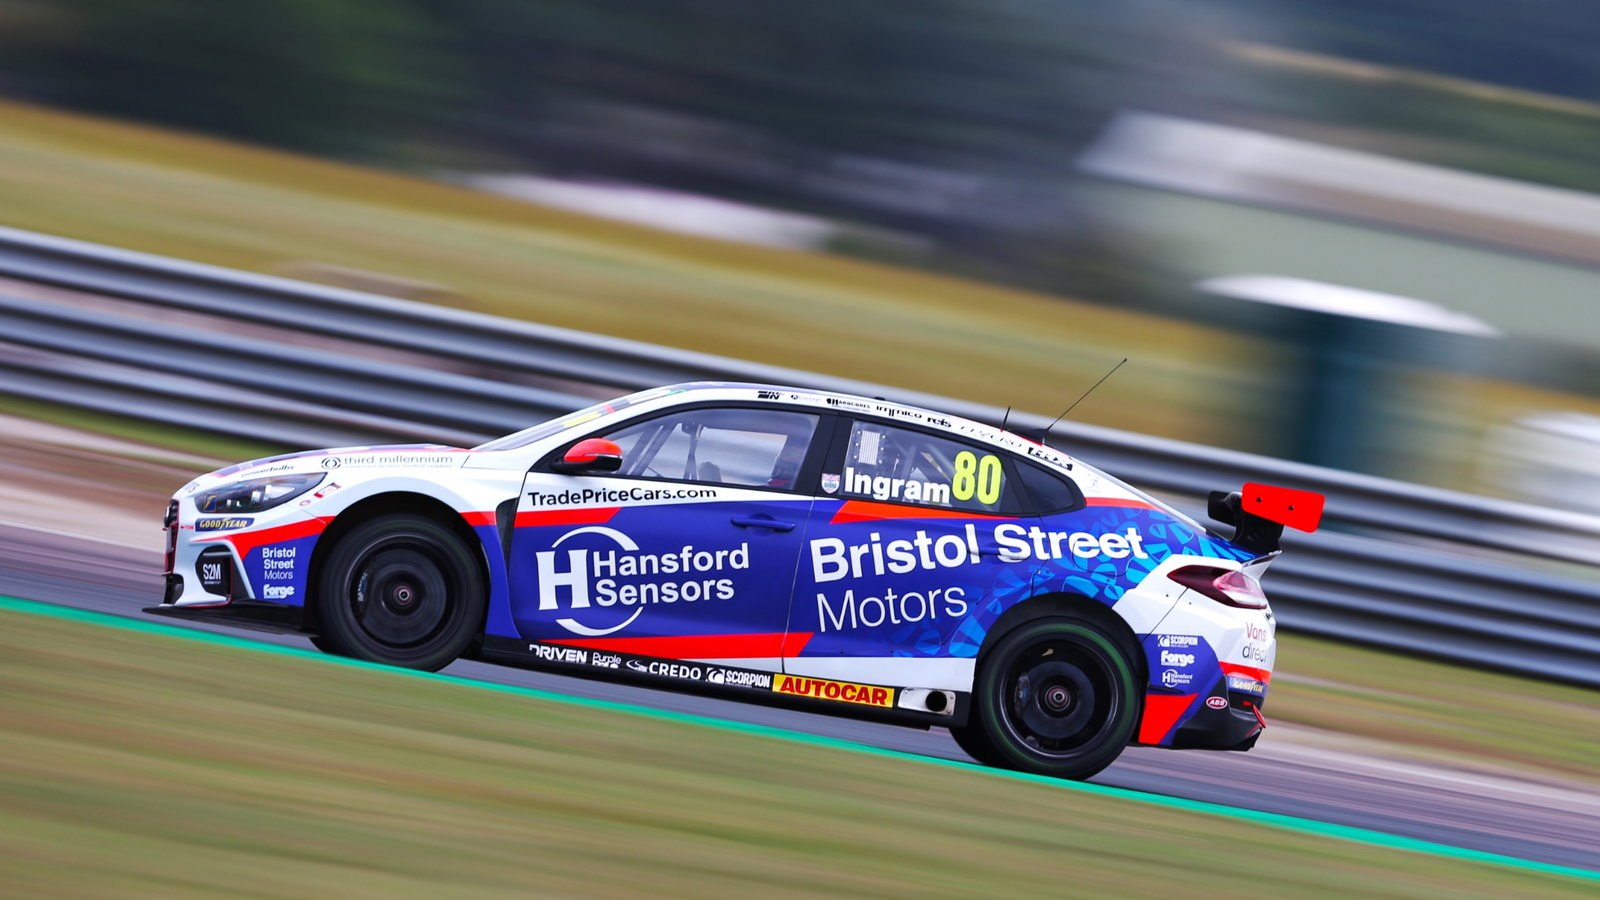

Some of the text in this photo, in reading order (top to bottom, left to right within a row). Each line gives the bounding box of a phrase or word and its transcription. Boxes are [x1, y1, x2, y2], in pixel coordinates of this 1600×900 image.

[344, 454, 453, 465] third millennium
[844, 467, 951, 504] Ingram
[952, 450, 1003, 505] 80
[527, 486, 717, 507] TradePriceCars.com
[199, 517, 248, 529] GOODYEAR
[262, 547, 296, 559] Bristol
[593, 542, 750, 577] Hansford
[810, 523, 1149, 583] Bristol Street
[202, 563, 221, 581] S2M
[263, 559, 295, 570] Street
[264, 569, 294, 580] Motors
[595, 578, 736, 607] Sensors
[816, 585, 969, 633] Motors
[1245, 621, 1267, 642] Vans
[529, 643, 588, 664] DRIVEN
[592, 651, 622, 666] Purple
[648, 661, 702, 681] CREDO
[725, 669, 771, 689] SCORPION
[779, 676, 888, 706] AUTOCAR
